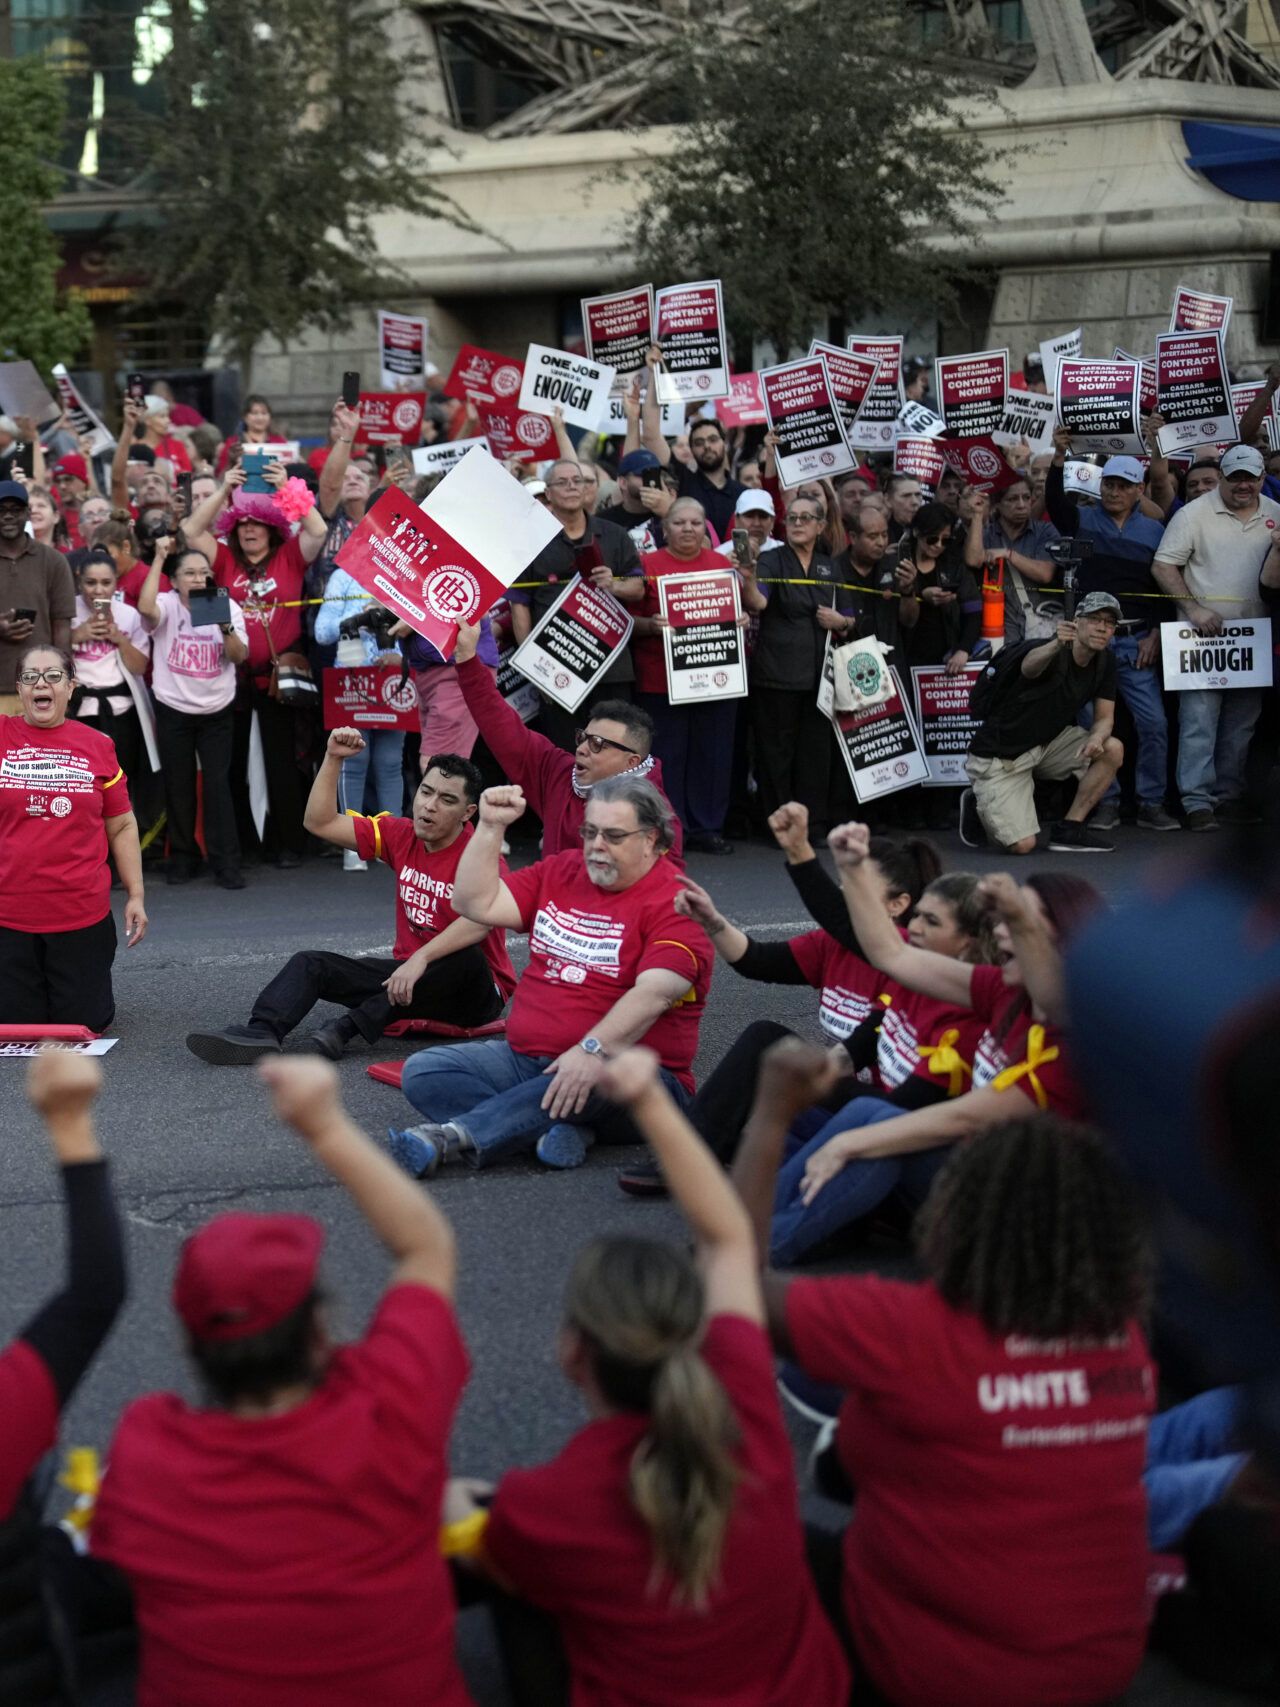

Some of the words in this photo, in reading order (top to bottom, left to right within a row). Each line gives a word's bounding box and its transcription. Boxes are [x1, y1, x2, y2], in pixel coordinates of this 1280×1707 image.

[603, 300, 634, 310] CAESARS
[595, 309, 648, 328] CONTRACT
[662, 306, 715, 320] CONTRACT
[1180, 308, 1222, 322] CONTRACT
[606, 322, 637, 335] NOW!!!
[670, 317, 703, 328] NOW!!!
[1185, 317, 1210, 328] NOW!!!
[671, 332, 703, 340] CAESARS
[1160, 347, 1215, 358] ENTERTAINMENT:
[1169, 342, 1199, 350] CAESARS
[541, 355, 572, 370] ONE
[573, 365, 600, 380] JOB
[671, 357, 709, 368] AHORA!
[958, 363, 989, 371] CAESARS
[1162, 356, 1216, 368] CONTRACT
[778, 370, 808, 382] CAESARS
[944, 367, 1002, 379] ENTERTAINMENT:
[1169, 367, 1203, 378] NOW!!!
[948, 375, 1003, 389] CONTRACT
[1170, 382, 1205, 391] CAESARS
[533, 374, 592, 411] ENOUGH
[772, 381, 823, 402] CONTRACT
[959, 386, 991, 397] NOW!!!
[782, 395, 814, 409] NOW!!!
[960, 400, 991, 410] CAESARS
[1008, 395, 1030, 406] ONE
[1031, 401, 1054, 411] JOB
[1064, 401, 1130, 411] ENTERTAINMENT:
[785, 410, 816, 422] CAESARS
[1065, 411, 1130, 424] ¡CONTRATO
[1171, 406, 1214, 419] AHORA!
[1079, 422, 1119, 431] AHORA!
[791, 434, 828, 450] AHORA!
[427, 450, 459, 462] ONE
[898, 458, 942, 469] CONTRACT
[383, 536, 412, 564] CULINARY
[368, 534, 396, 565] WORKERS
[395, 556, 417, 582] UNION
[683, 582, 716, 591] CAESARS
[668, 587, 732, 600] ENTERTAINMENT:
[673, 597, 731, 611] CONTRACT
[575, 592, 624, 635] CONTRACT
[684, 609, 719, 620] NOW!!!
[577, 607, 608, 634] NOW!!!
[569, 620, 598, 645] CAESARS
[687, 624, 720, 634] CAESARS
[552, 616, 606, 660] ENTERTAINMENT:
[672, 630, 735, 643] ENTERTAINMENT:
[544, 626, 599, 669] ¡CONTRATO
[674, 640, 736, 657] ¡CONTRATO
[547, 640, 585, 671] AHORA!
[686, 652, 727, 665] AHORA!
[1180, 647, 1253, 673] ENOUGH
[854, 704, 886, 722] NOW!!!
[859, 719, 890, 733] CAESARS
[851, 730, 909, 757] ¡CONTRATO
[864, 742, 902, 763] AHORA!
[18, 762, 29, 770] JOB
[31, 762, 56, 770] SHOULD
[548, 923, 561, 936] JOB
[561, 933, 588, 948] SHOULD
[589, 941, 596, 950] BE
[978, 1369, 1090, 1413] UNITE
